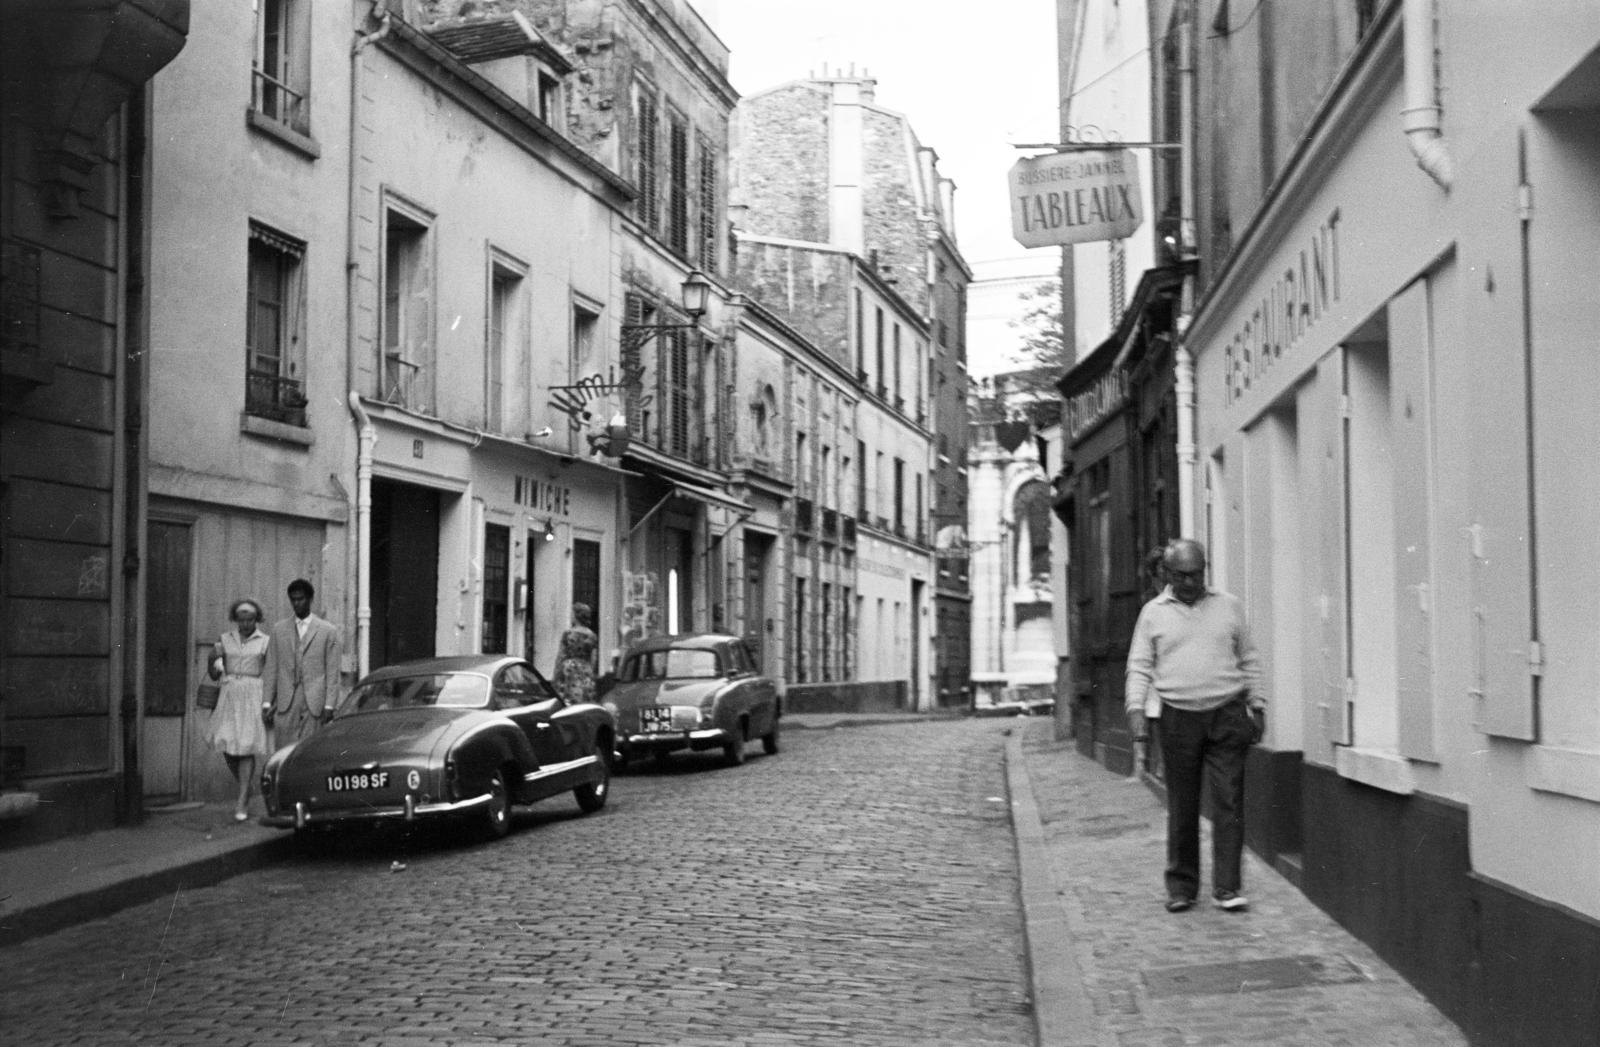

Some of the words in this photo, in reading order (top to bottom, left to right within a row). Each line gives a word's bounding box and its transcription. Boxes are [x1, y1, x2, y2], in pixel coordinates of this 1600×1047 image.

[1018, 183, 1135, 232] TABLEAUX
[1224, 206, 1341, 411] RESTAURANT
[327, 775, 369, 791] 10198
[371, 772, 389, 788] SF
